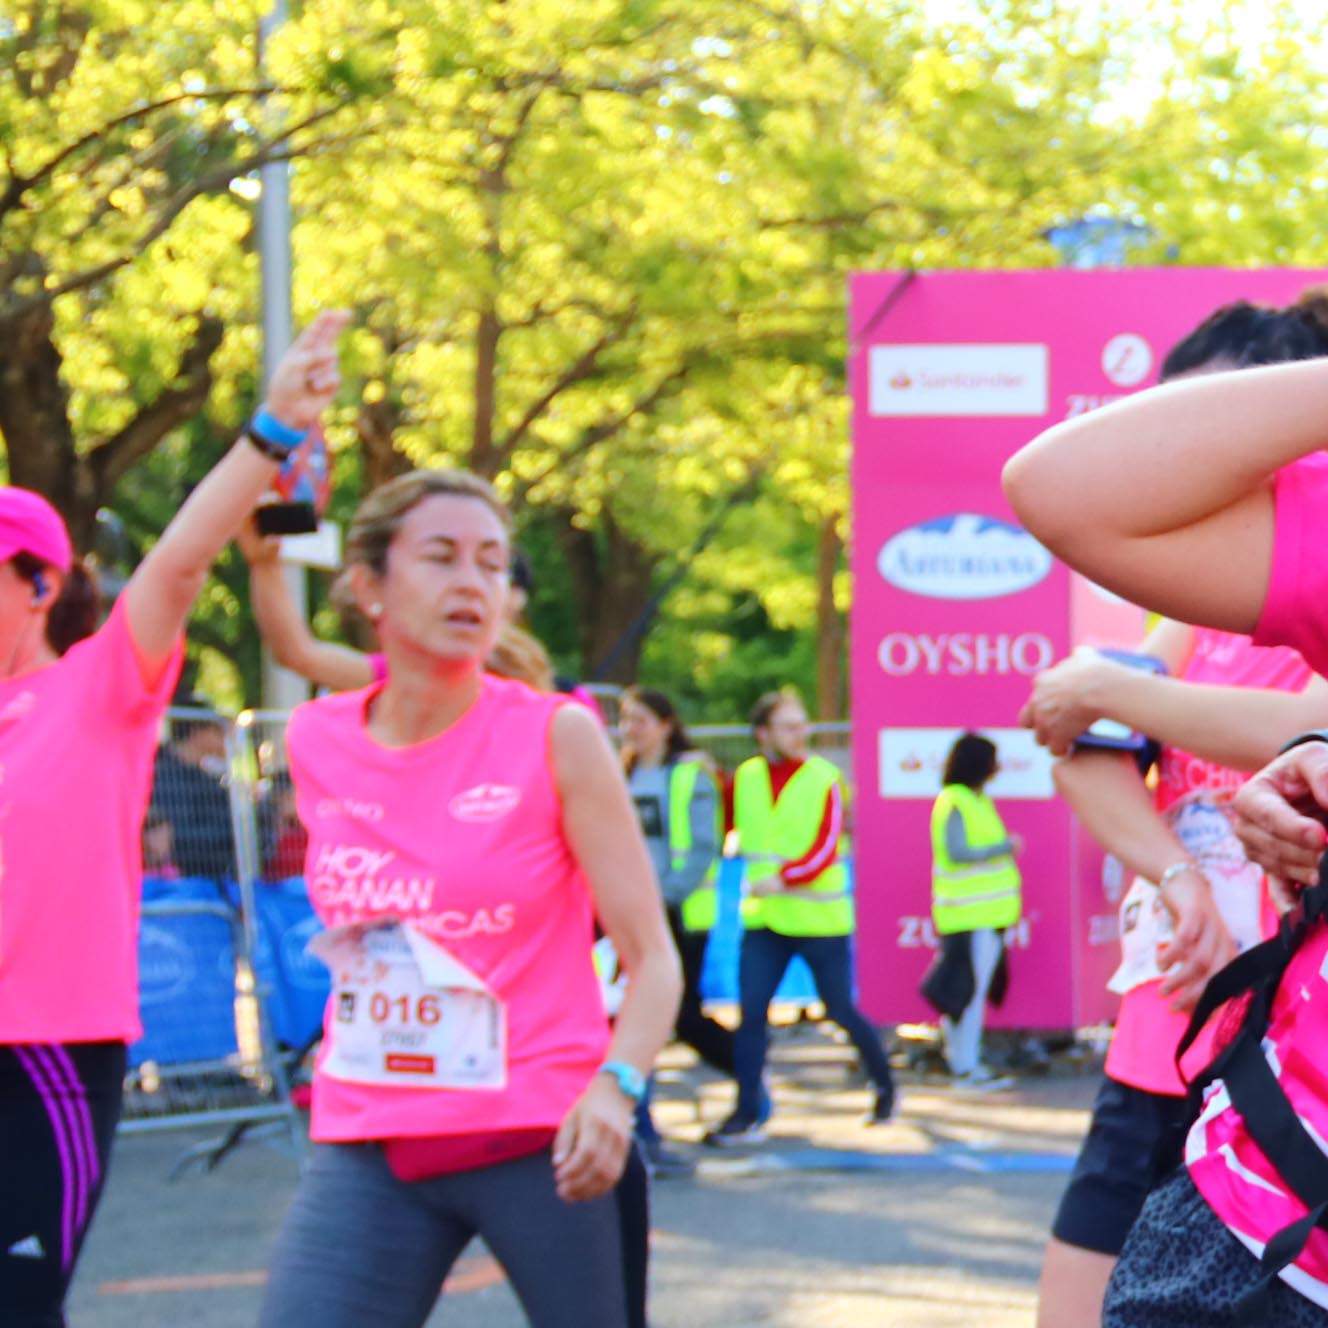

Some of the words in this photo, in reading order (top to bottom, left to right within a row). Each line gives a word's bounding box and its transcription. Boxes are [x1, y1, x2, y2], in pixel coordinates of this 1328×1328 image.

[890, 542, 1036, 578] ASTURIANA
[877, 633, 1053, 675] OYSHO
[314, 846, 396, 879] HOY
[314, 876, 435, 910] GANAN
[370, 992, 442, 1026] 016
